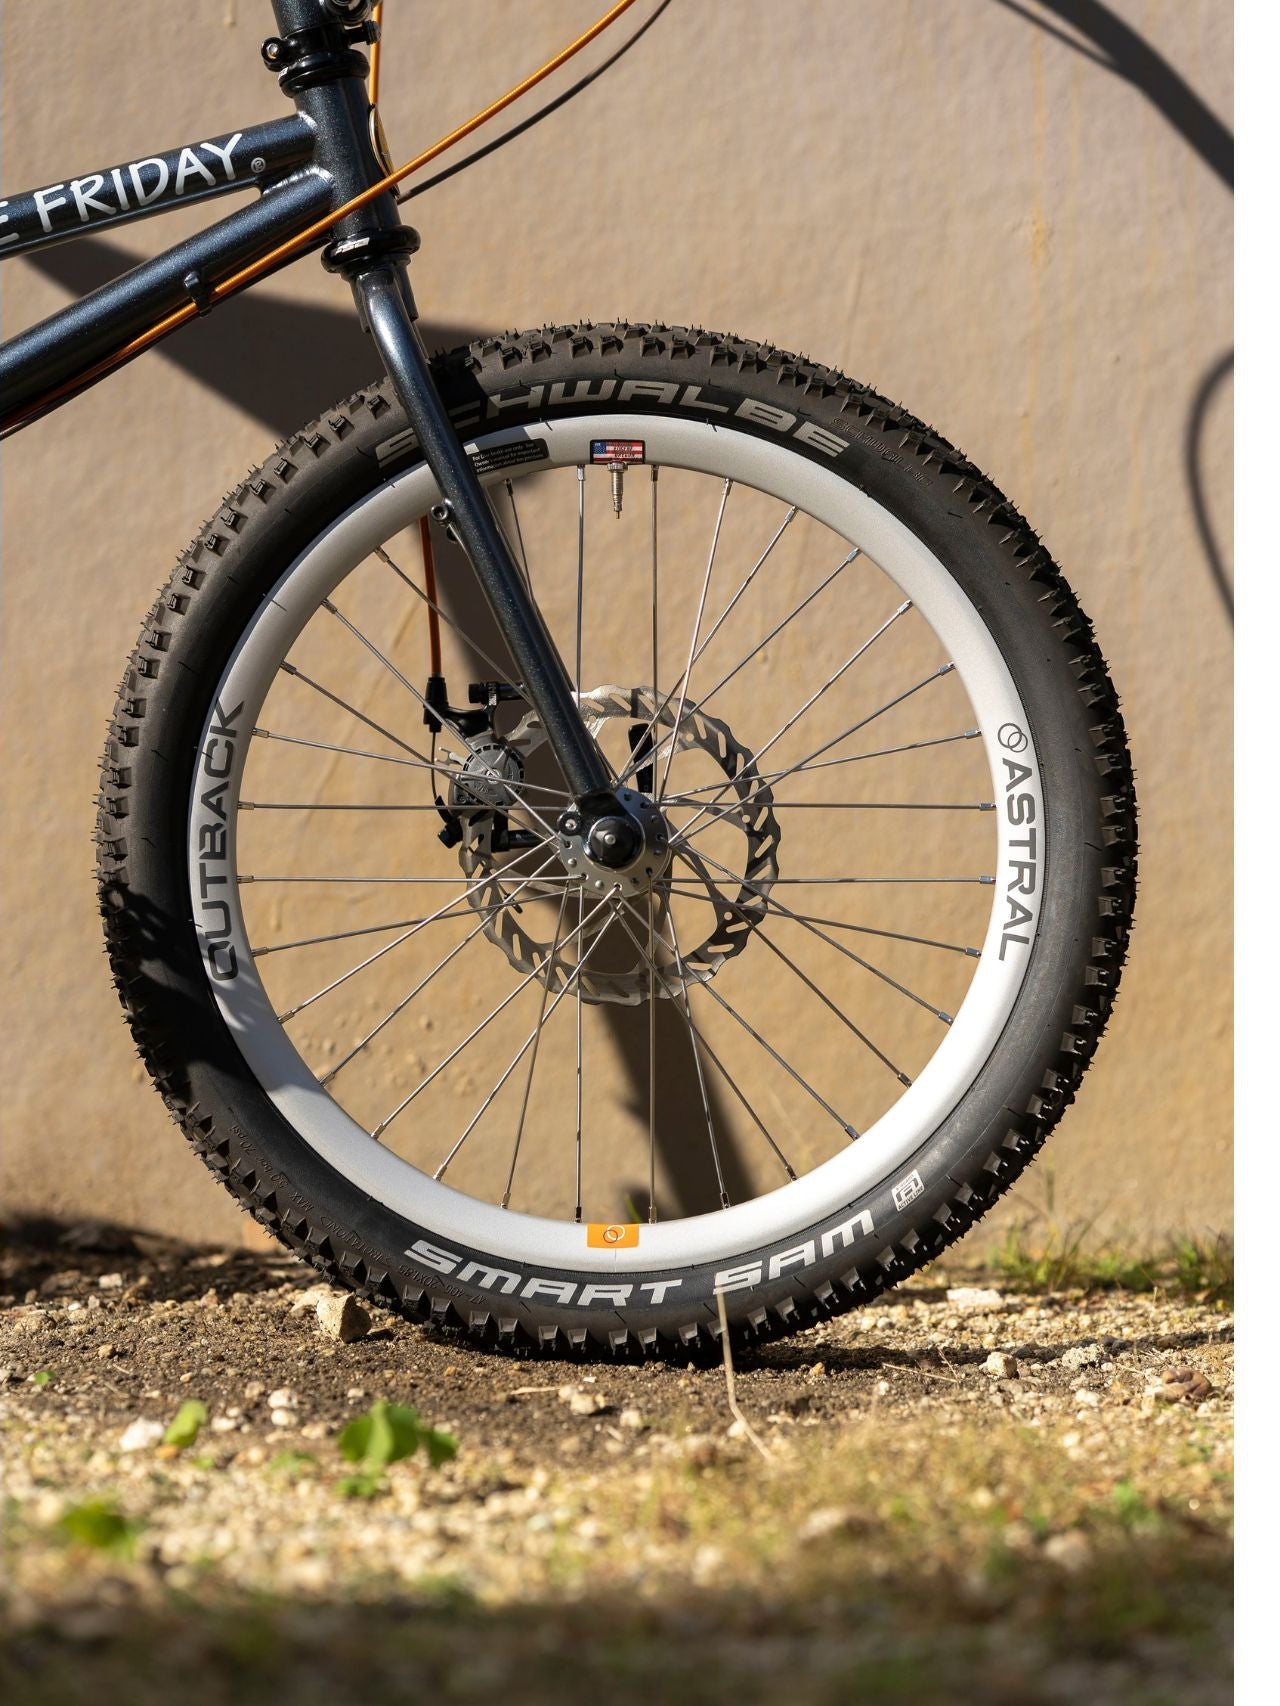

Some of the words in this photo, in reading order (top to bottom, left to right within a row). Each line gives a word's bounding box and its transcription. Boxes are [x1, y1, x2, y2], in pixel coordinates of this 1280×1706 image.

[33, 133, 243, 232] FRIDAY
[199, 696, 244, 981] OUTBACK
[998, 757, 1037, 961] ASTRAL
[404, 1239, 683, 1308] SMART
[712, 1209, 876, 1296] SAM
